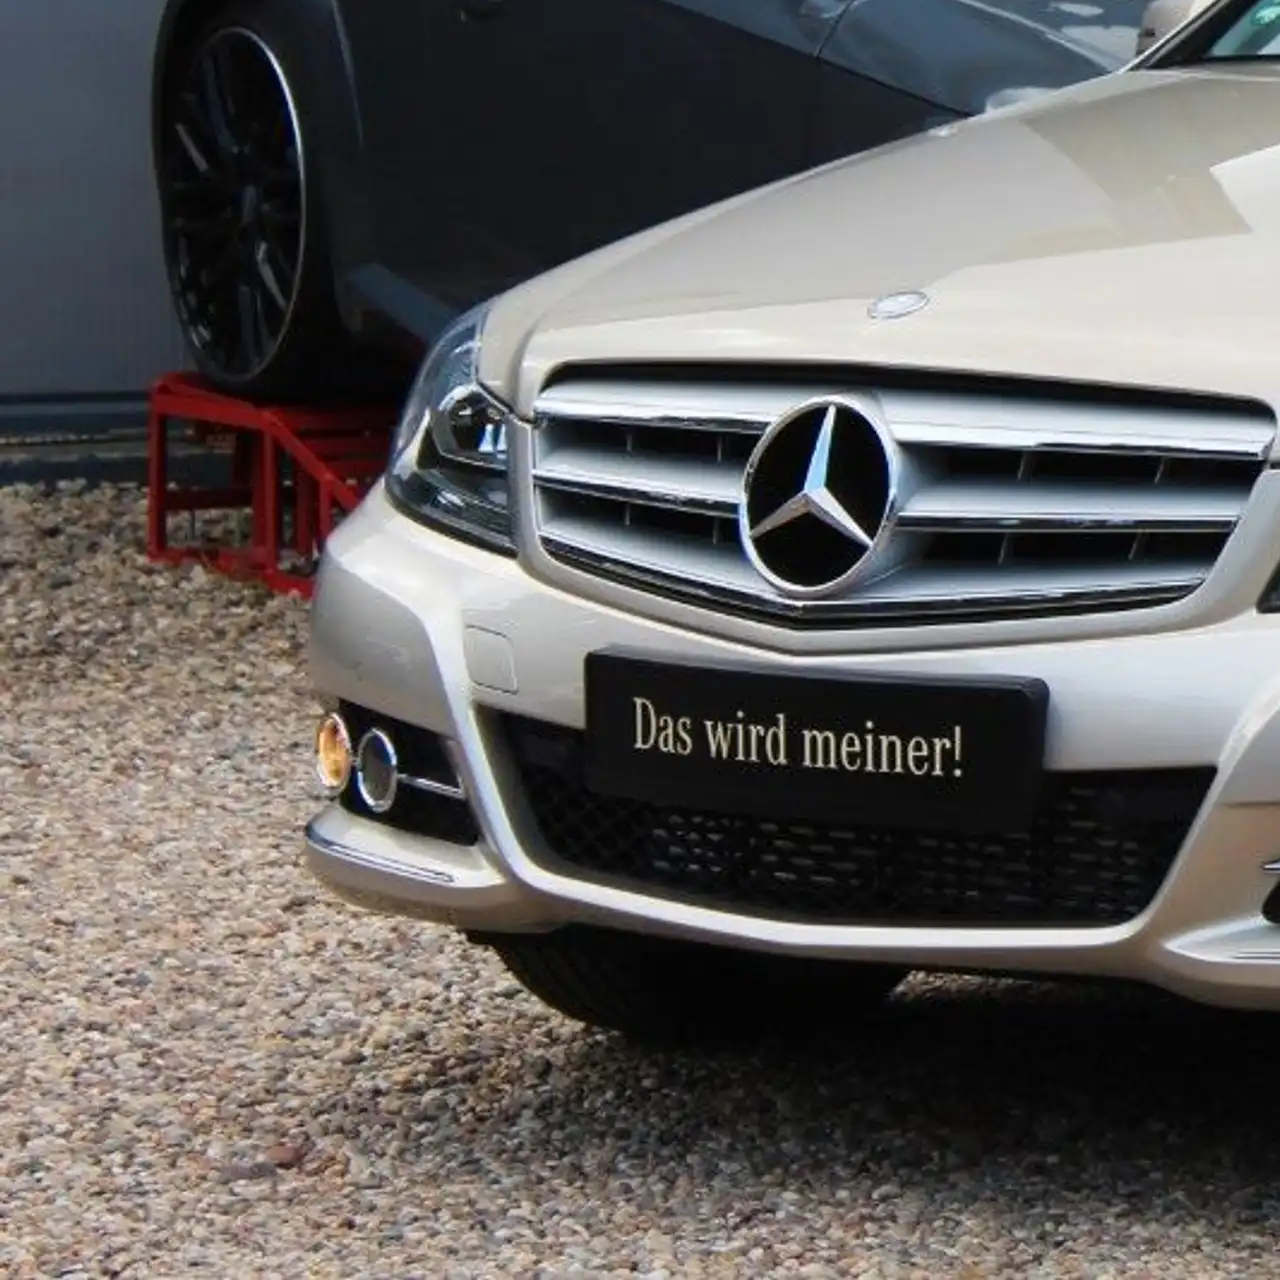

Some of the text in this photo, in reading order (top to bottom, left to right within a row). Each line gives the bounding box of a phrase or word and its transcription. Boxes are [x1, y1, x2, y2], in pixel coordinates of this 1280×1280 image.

[632, 696, 964, 778] Das wird meiner!
